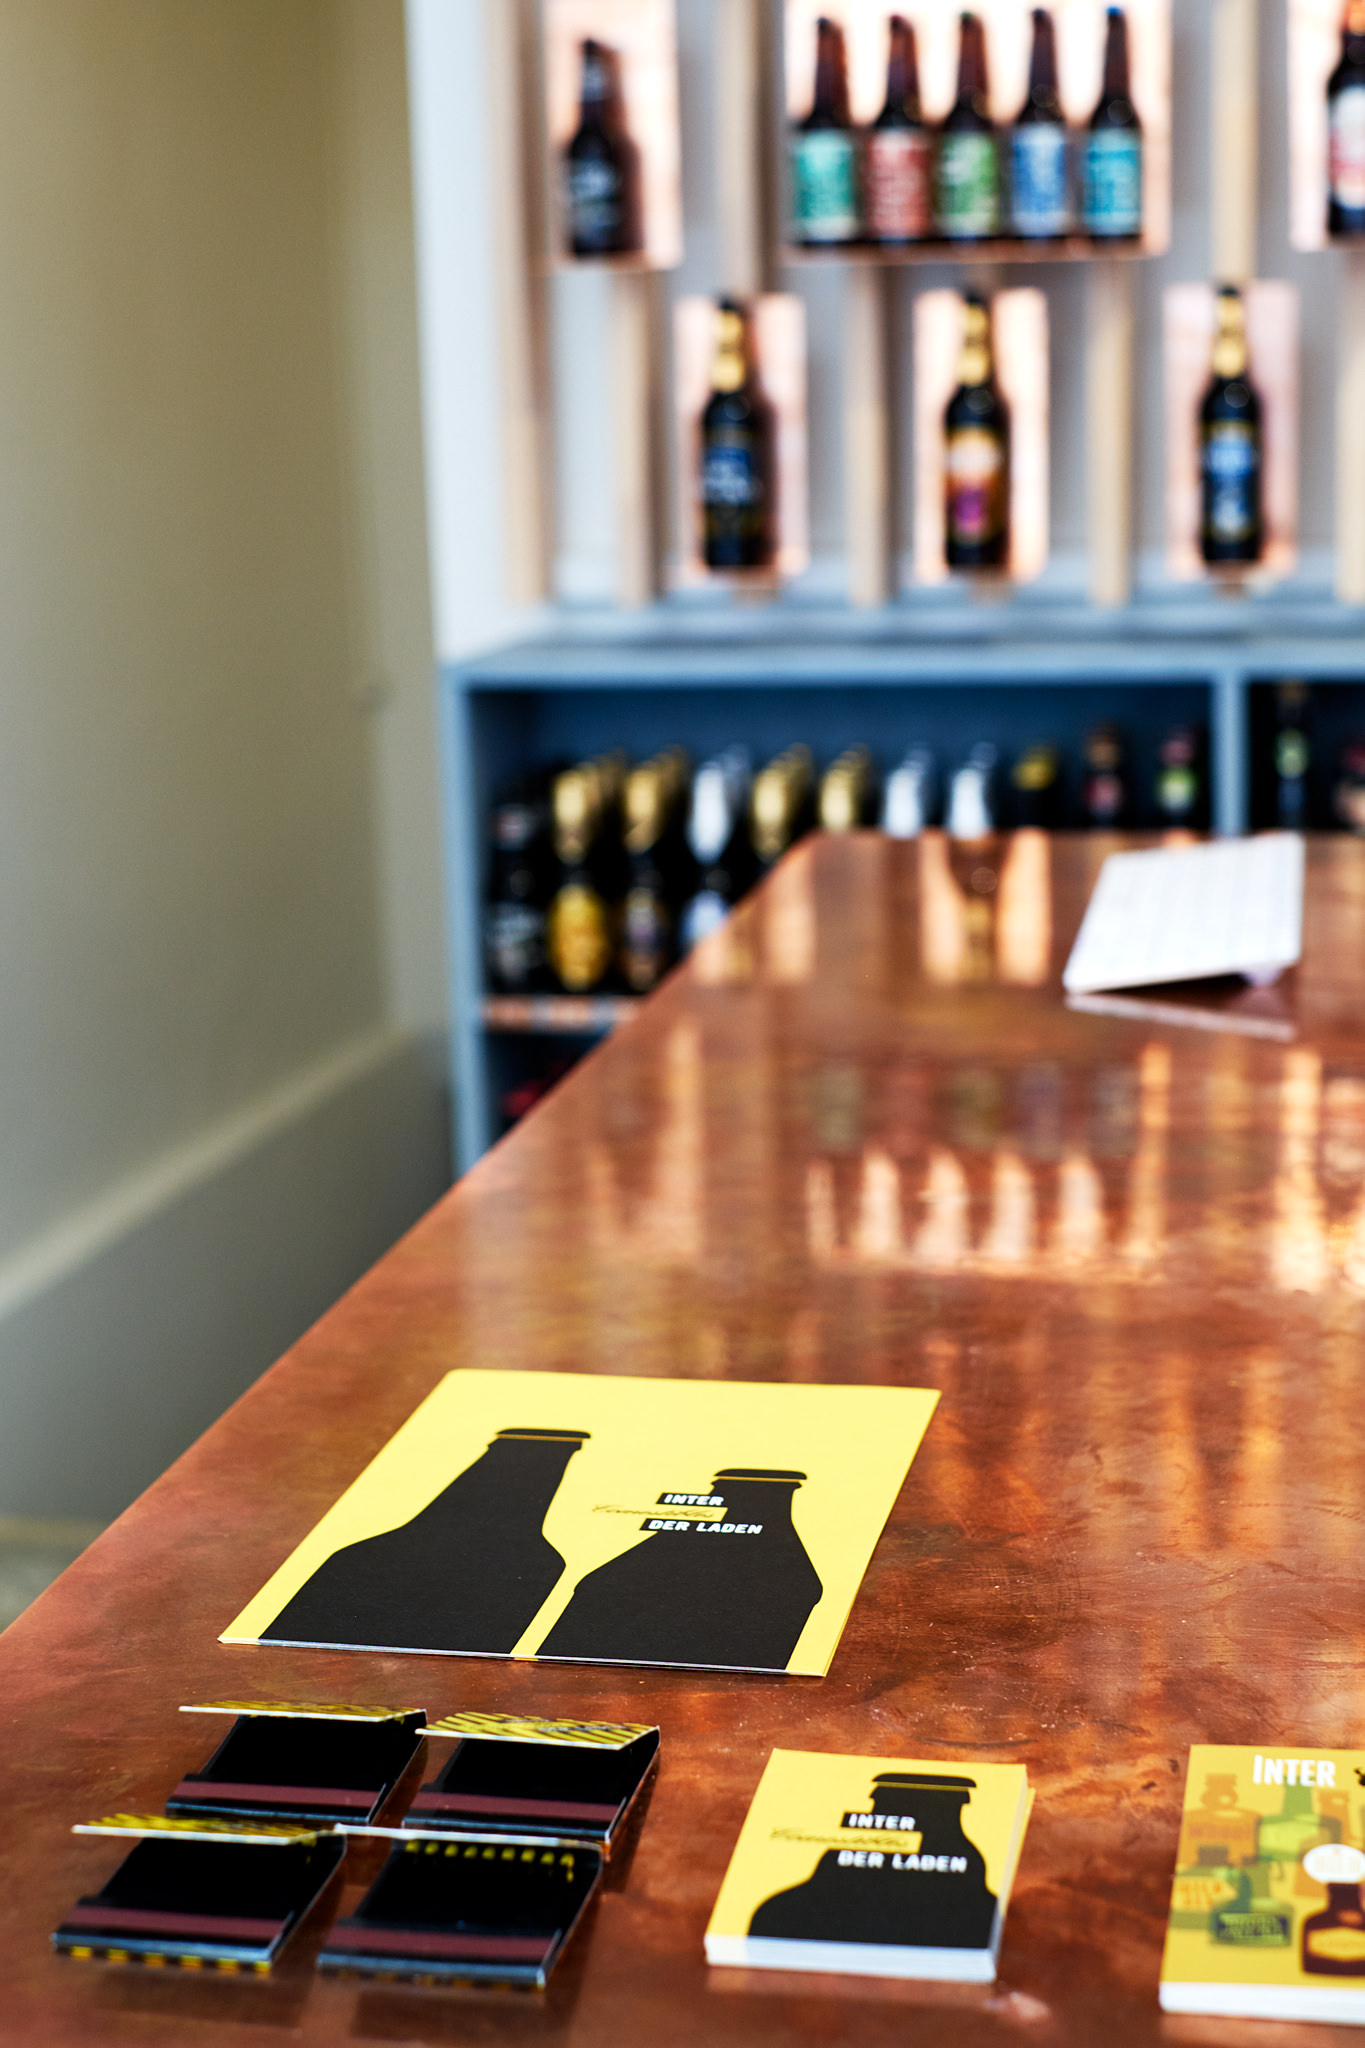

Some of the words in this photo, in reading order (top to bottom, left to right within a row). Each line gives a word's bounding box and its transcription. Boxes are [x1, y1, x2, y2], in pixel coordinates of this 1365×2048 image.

[663, 1493, 724, 1506] INTER
[648, 1519, 690, 1532] DER
[695, 1522, 763, 1535] LADEN
[1252, 1754, 1337, 1787] INTER
[848, 1813, 916, 1831] INTER
[837, 1849, 885, 1869] DER
[891, 1853, 968, 1874] LADEN
